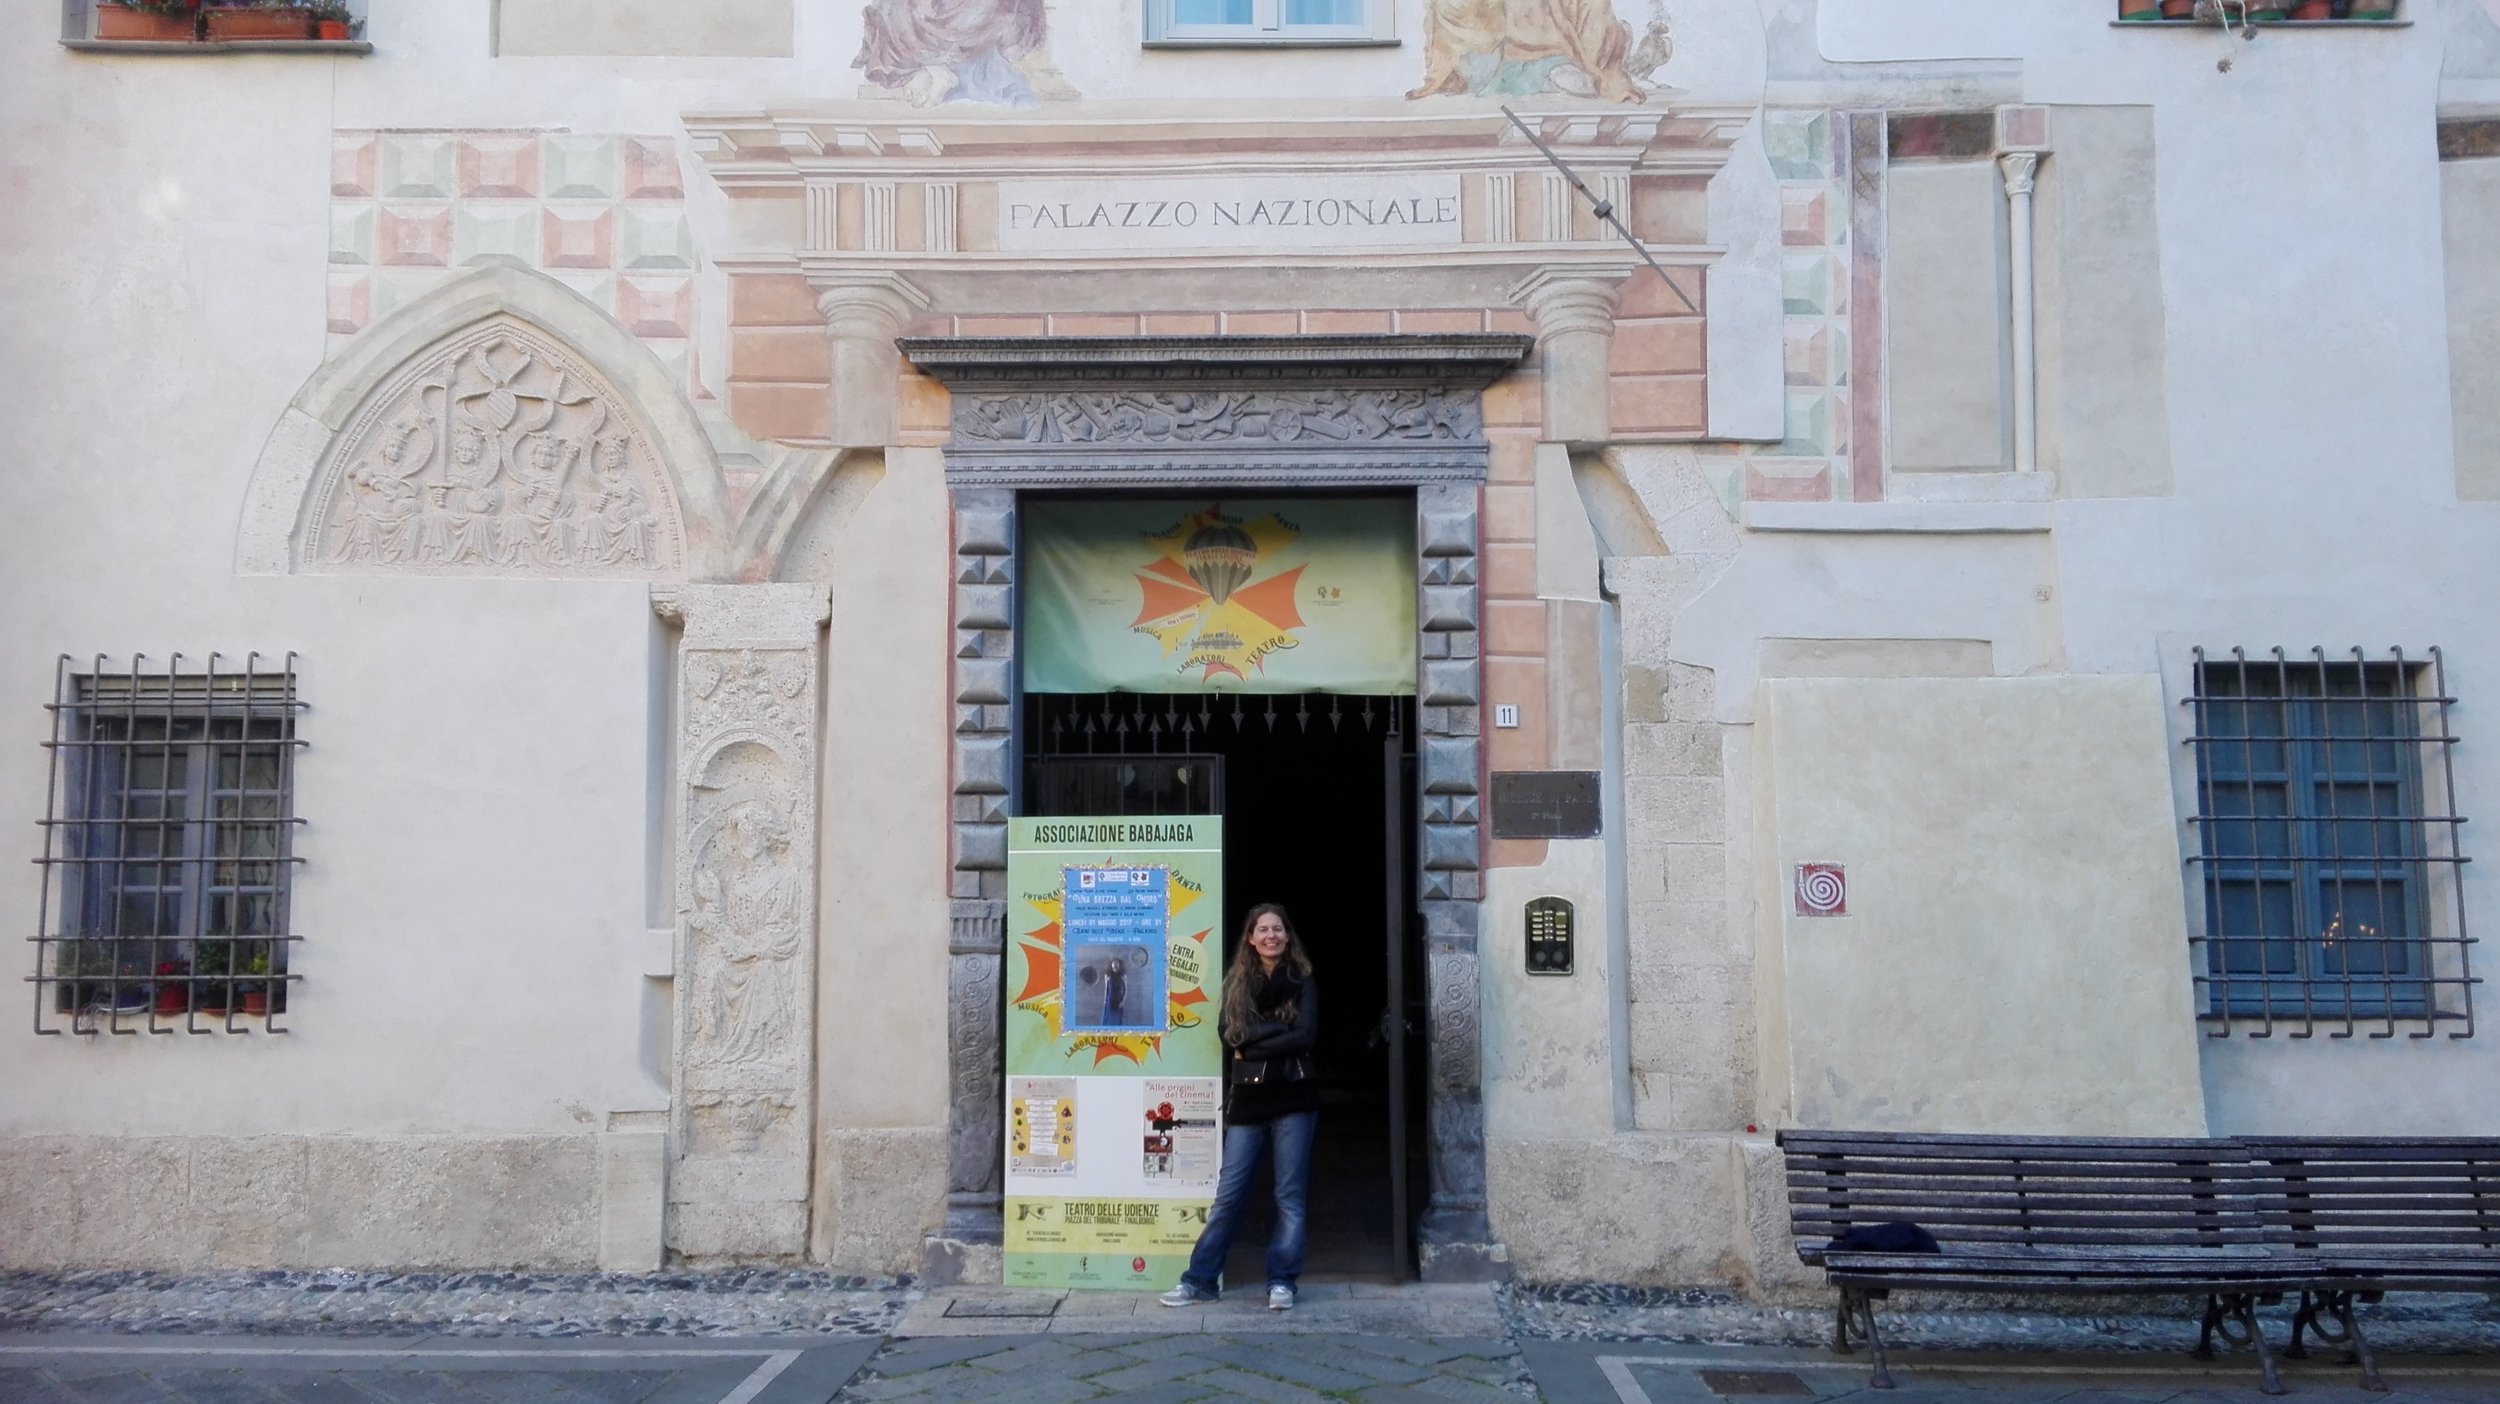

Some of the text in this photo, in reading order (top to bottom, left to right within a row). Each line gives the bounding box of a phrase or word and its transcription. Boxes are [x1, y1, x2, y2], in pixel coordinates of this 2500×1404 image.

[1011, 195, 1457, 229] PALAZZO NAZIONALE
[1133, 627, 1162, 641] MUSICA
[1245, 634, 1290, 666] TEATRO
[1176, 653, 1226, 674] LABORATORI
[1501, 707, 1512, 724] 11
[1034, 823, 1194, 843] ASSOCIAZIONE BABAJAGA
[1171, 868, 1203, 893] DANZA
[1119, 918, 1133, 927] 2017
[1172, 943, 1194, 960] ENTRA
[1018, 1003, 1049, 1019] MUSICA
[1064, 1035, 1119, 1058] LABORATORI
[1149, 1083, 1195, 1093] Alle origini
[1164, 1091, 1178, 1099] del
[1064, 1203, 1159, 1217] TEATRO DELLE UDIENZE
[1064, 1216, 1083, 1224] PIAZZA
[1093, 1216, 1120, 1225] TRIBUNALE
